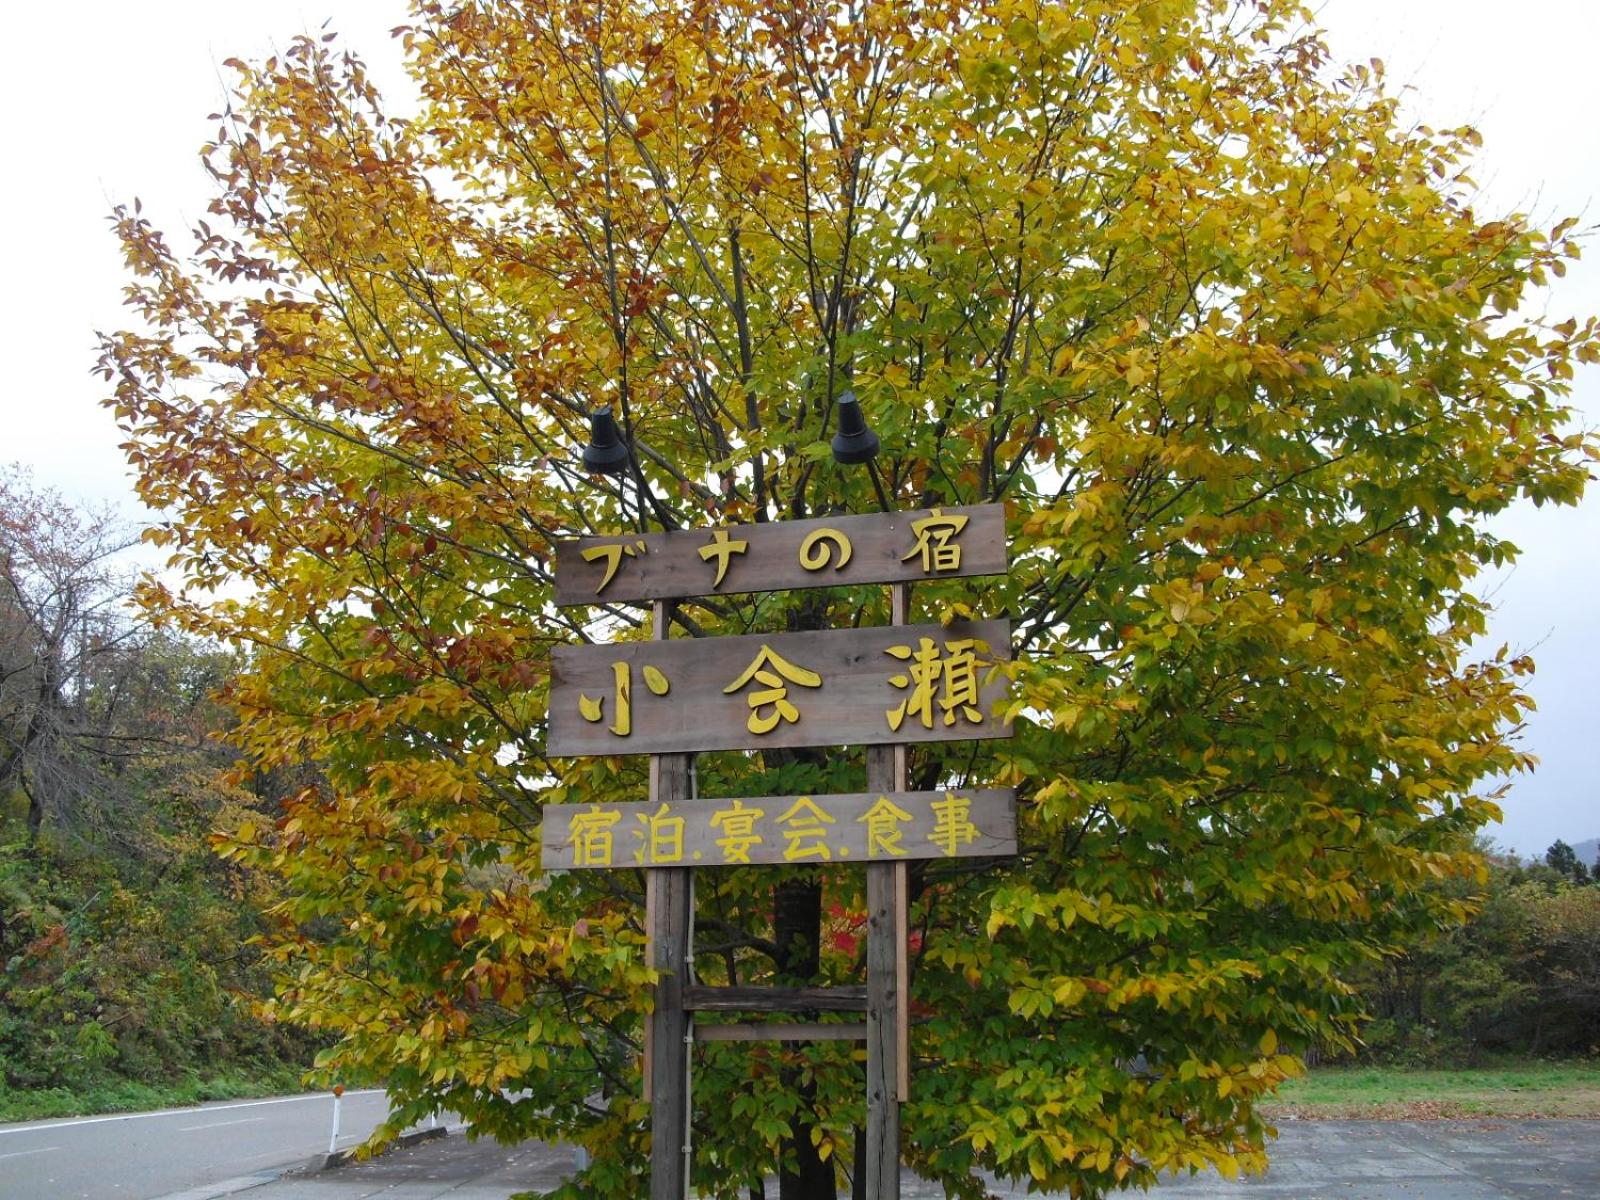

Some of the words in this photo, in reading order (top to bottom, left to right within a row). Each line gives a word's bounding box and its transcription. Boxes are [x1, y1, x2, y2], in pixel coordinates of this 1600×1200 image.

[580, 508, 969, 594] ブナの宿
[578, 637, 984, 736] 小会瀬
